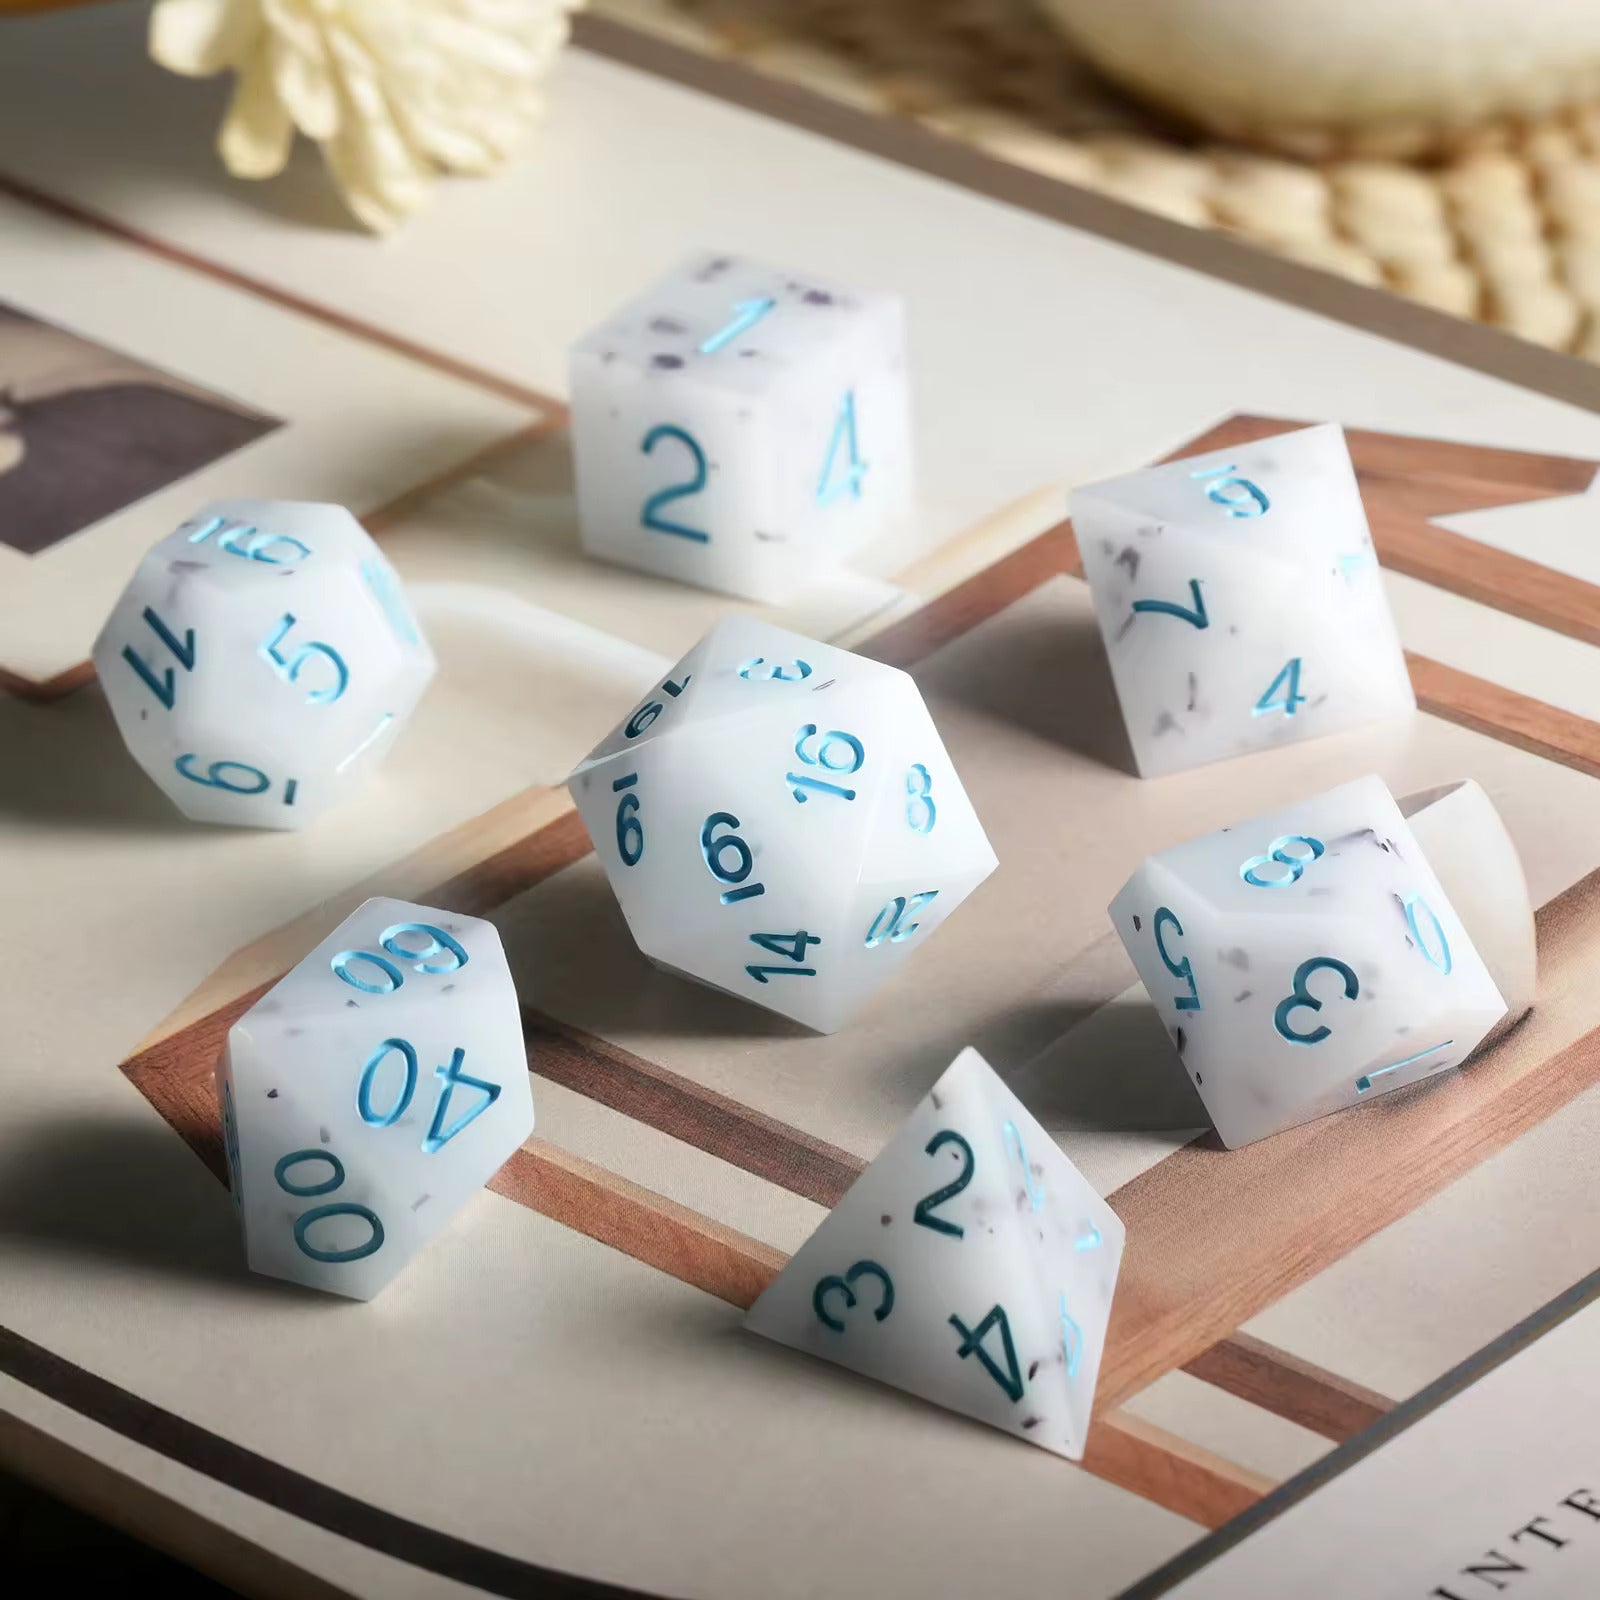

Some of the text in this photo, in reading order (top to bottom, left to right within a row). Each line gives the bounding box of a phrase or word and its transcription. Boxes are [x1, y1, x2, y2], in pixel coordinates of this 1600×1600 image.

[701, 298, 776, 352] 1
[640, 423, 710, 543] 2
[817, 387, 868, 507] 4
[1132, 578, 1208, 629] 7
[122, 606, 195, 711] 11
[257, 612, 349, 705] 5
[737, 657, 812, 681] 3
[1251, 657, 1306, 719] 4
[785, 723, 865, 804] 16
[904, 763, 936, 838] 8
[1239, 835, 1325, 888] 8
[745, 931, 821, 983] 14
[1153, 907, 1202, 1012] 5
[1273, 956, 1359, 1046] 3
[356, 1037, 502, 1155] 40
[913, 1129, 975, 1240] 2
[812, 1259, 895, 1334] 3
[947, 1304, 1025, 1404] 4
